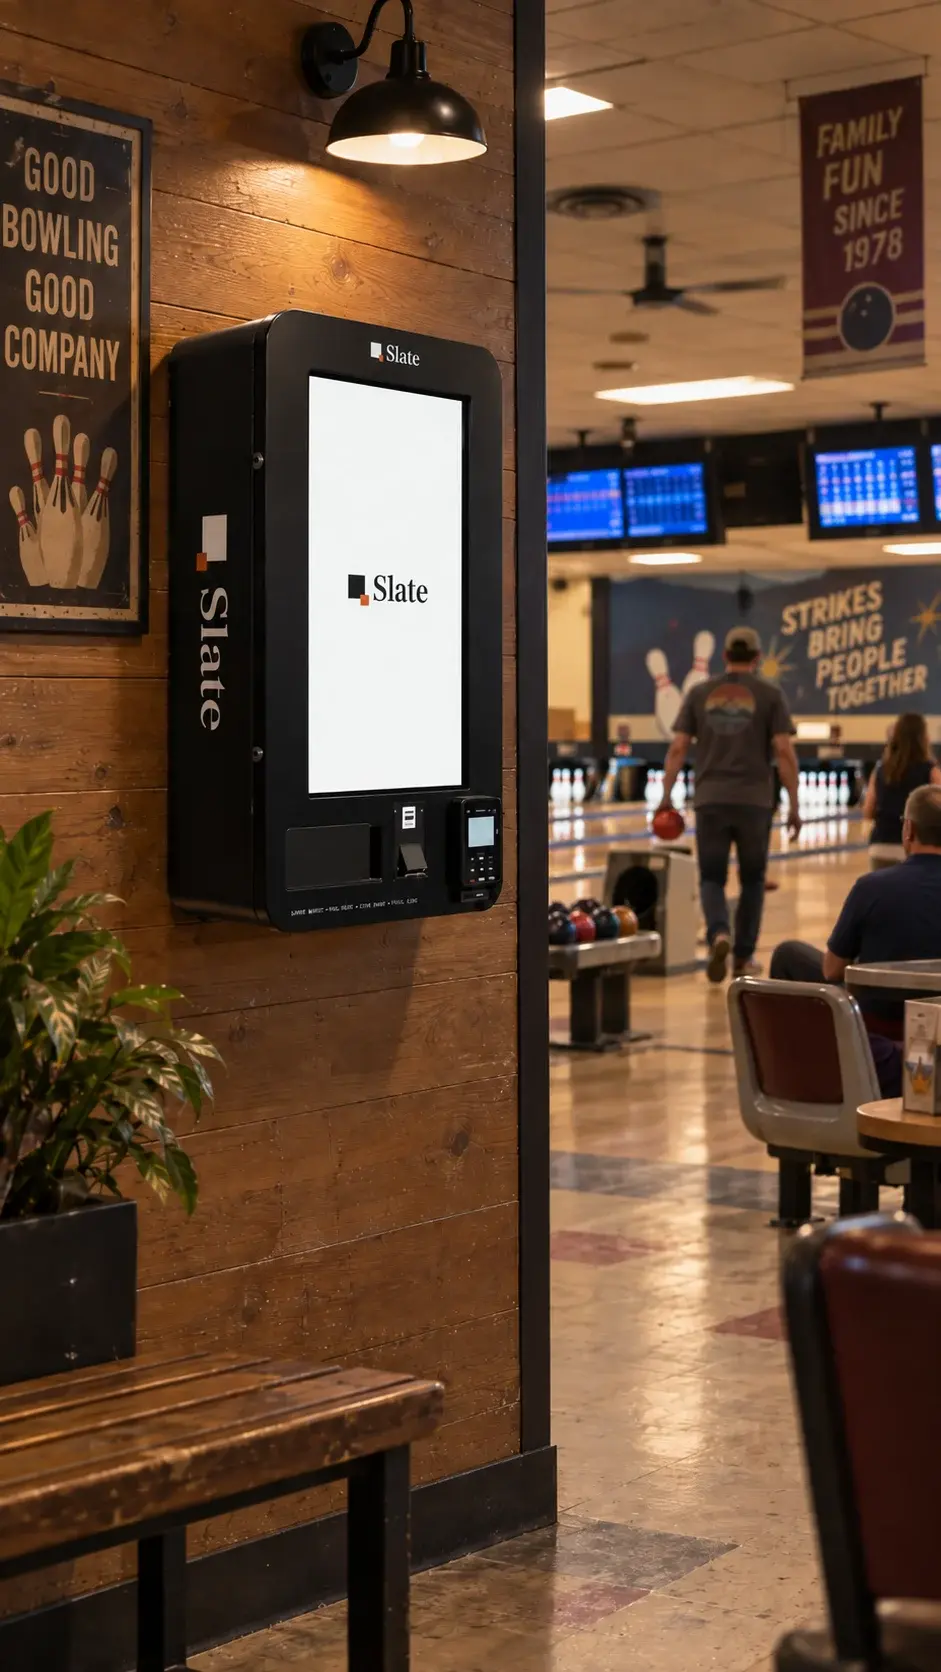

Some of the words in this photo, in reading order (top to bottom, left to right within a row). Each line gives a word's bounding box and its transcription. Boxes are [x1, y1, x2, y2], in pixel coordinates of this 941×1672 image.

[816, 106, 904, 159] FAMILY
[24, 147, 95, 202] GOOD
[823, 149, 884, 201] FUN
[2, 203, 119, 267] BOWLING
[832, 188, 905, 236] SINCE
[843, 227, 904, 272] 1978
[25, 269, 94, 321] GOOD
[4, 324, 120, 382] COMPANY
[386, 344, 420, 367] Slate
[373, 574, 428, 603] Slate
[780, 580, 884, 636] STRIKES
[200, 587, 229, 731] Slate
[807, 612, 884, 660] BRING
[815, 636, 908, 690] PEOPLE
[826, 663, 929, 713] TOGETHER
